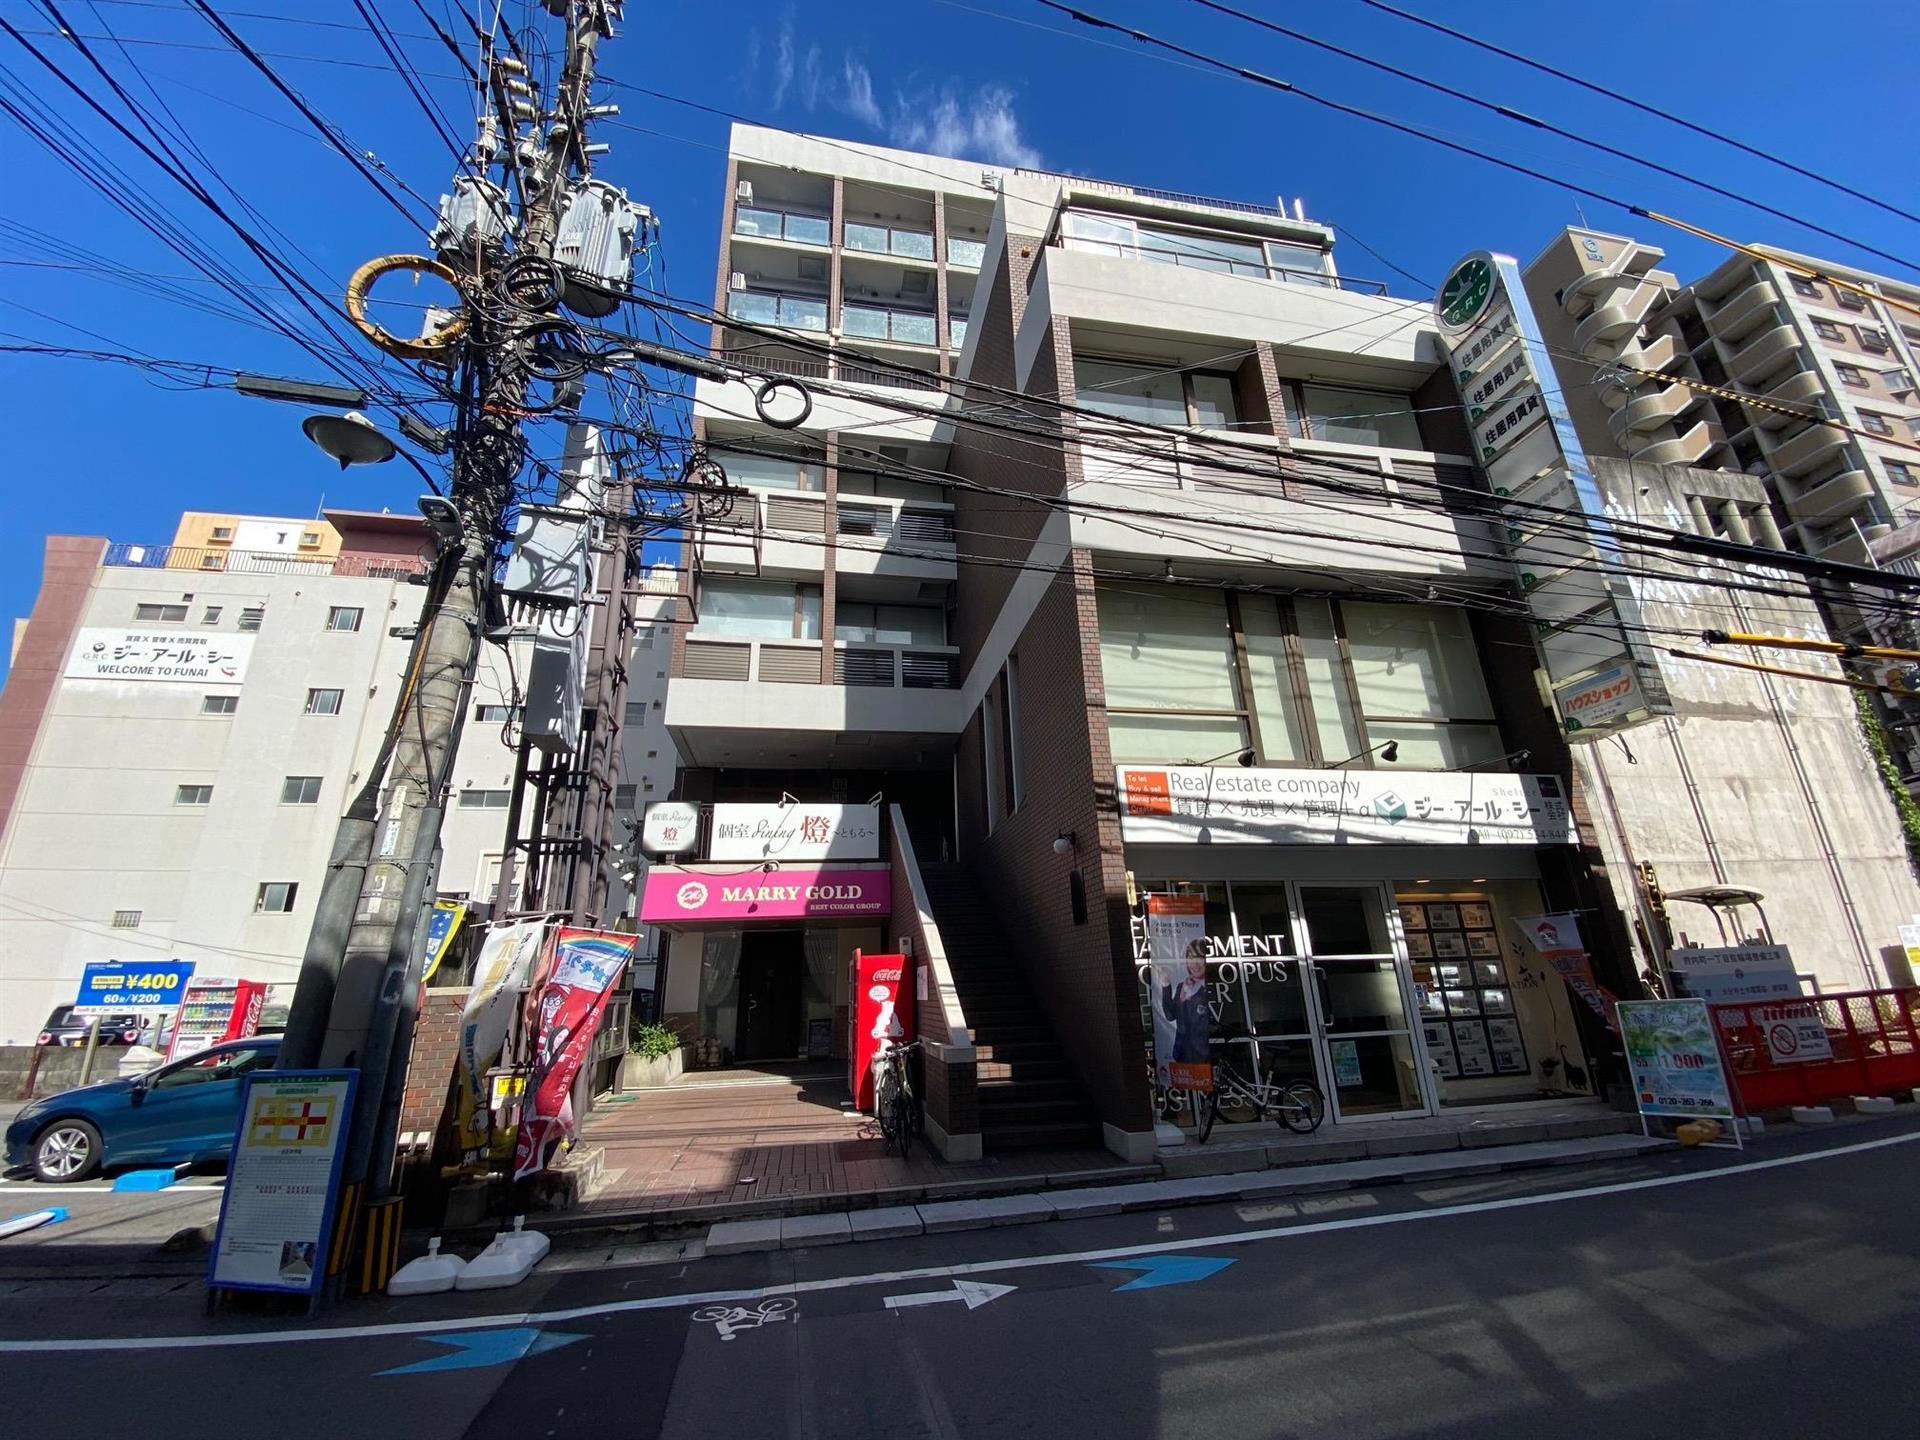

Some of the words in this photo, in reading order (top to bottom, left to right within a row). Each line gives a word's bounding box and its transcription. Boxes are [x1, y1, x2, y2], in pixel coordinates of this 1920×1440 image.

[1473, 352, 1526, 404] 住居用賃貸
[1485, 393, 1539, 445] 住居用賃貸
[97, 664, 154, 675] WELCOME
[158, 667, 172, 675] TO
[173, 667, 209, 677] FUNAI
[1565, 676, 1632, 713] ハウスショップ
[1127, 774, 1137, 782] To
[1128, 784, 1141, 793] Buy
[1171, 772, 1209, 791] Real
[1216, 776, 1272, 793] estate
[1277, 777, 1360, 798] company
[1175, 797, 1212, 816] 賃貸
[1240, 798, 1277, 817] 売買
[1303, 799, 1341, 818] 管理
[1414, 797, 1540, 820] ジー・アール・シー
[718, 823, 750, 839] 個室
[751, 819, 796, 848] dining
[800, 816, 831, 844] 燈
[720, 885, 802, 902] MARRY
[805, 885, 862, 899] GOLD
[126, 973, 179, 989] ¥400
